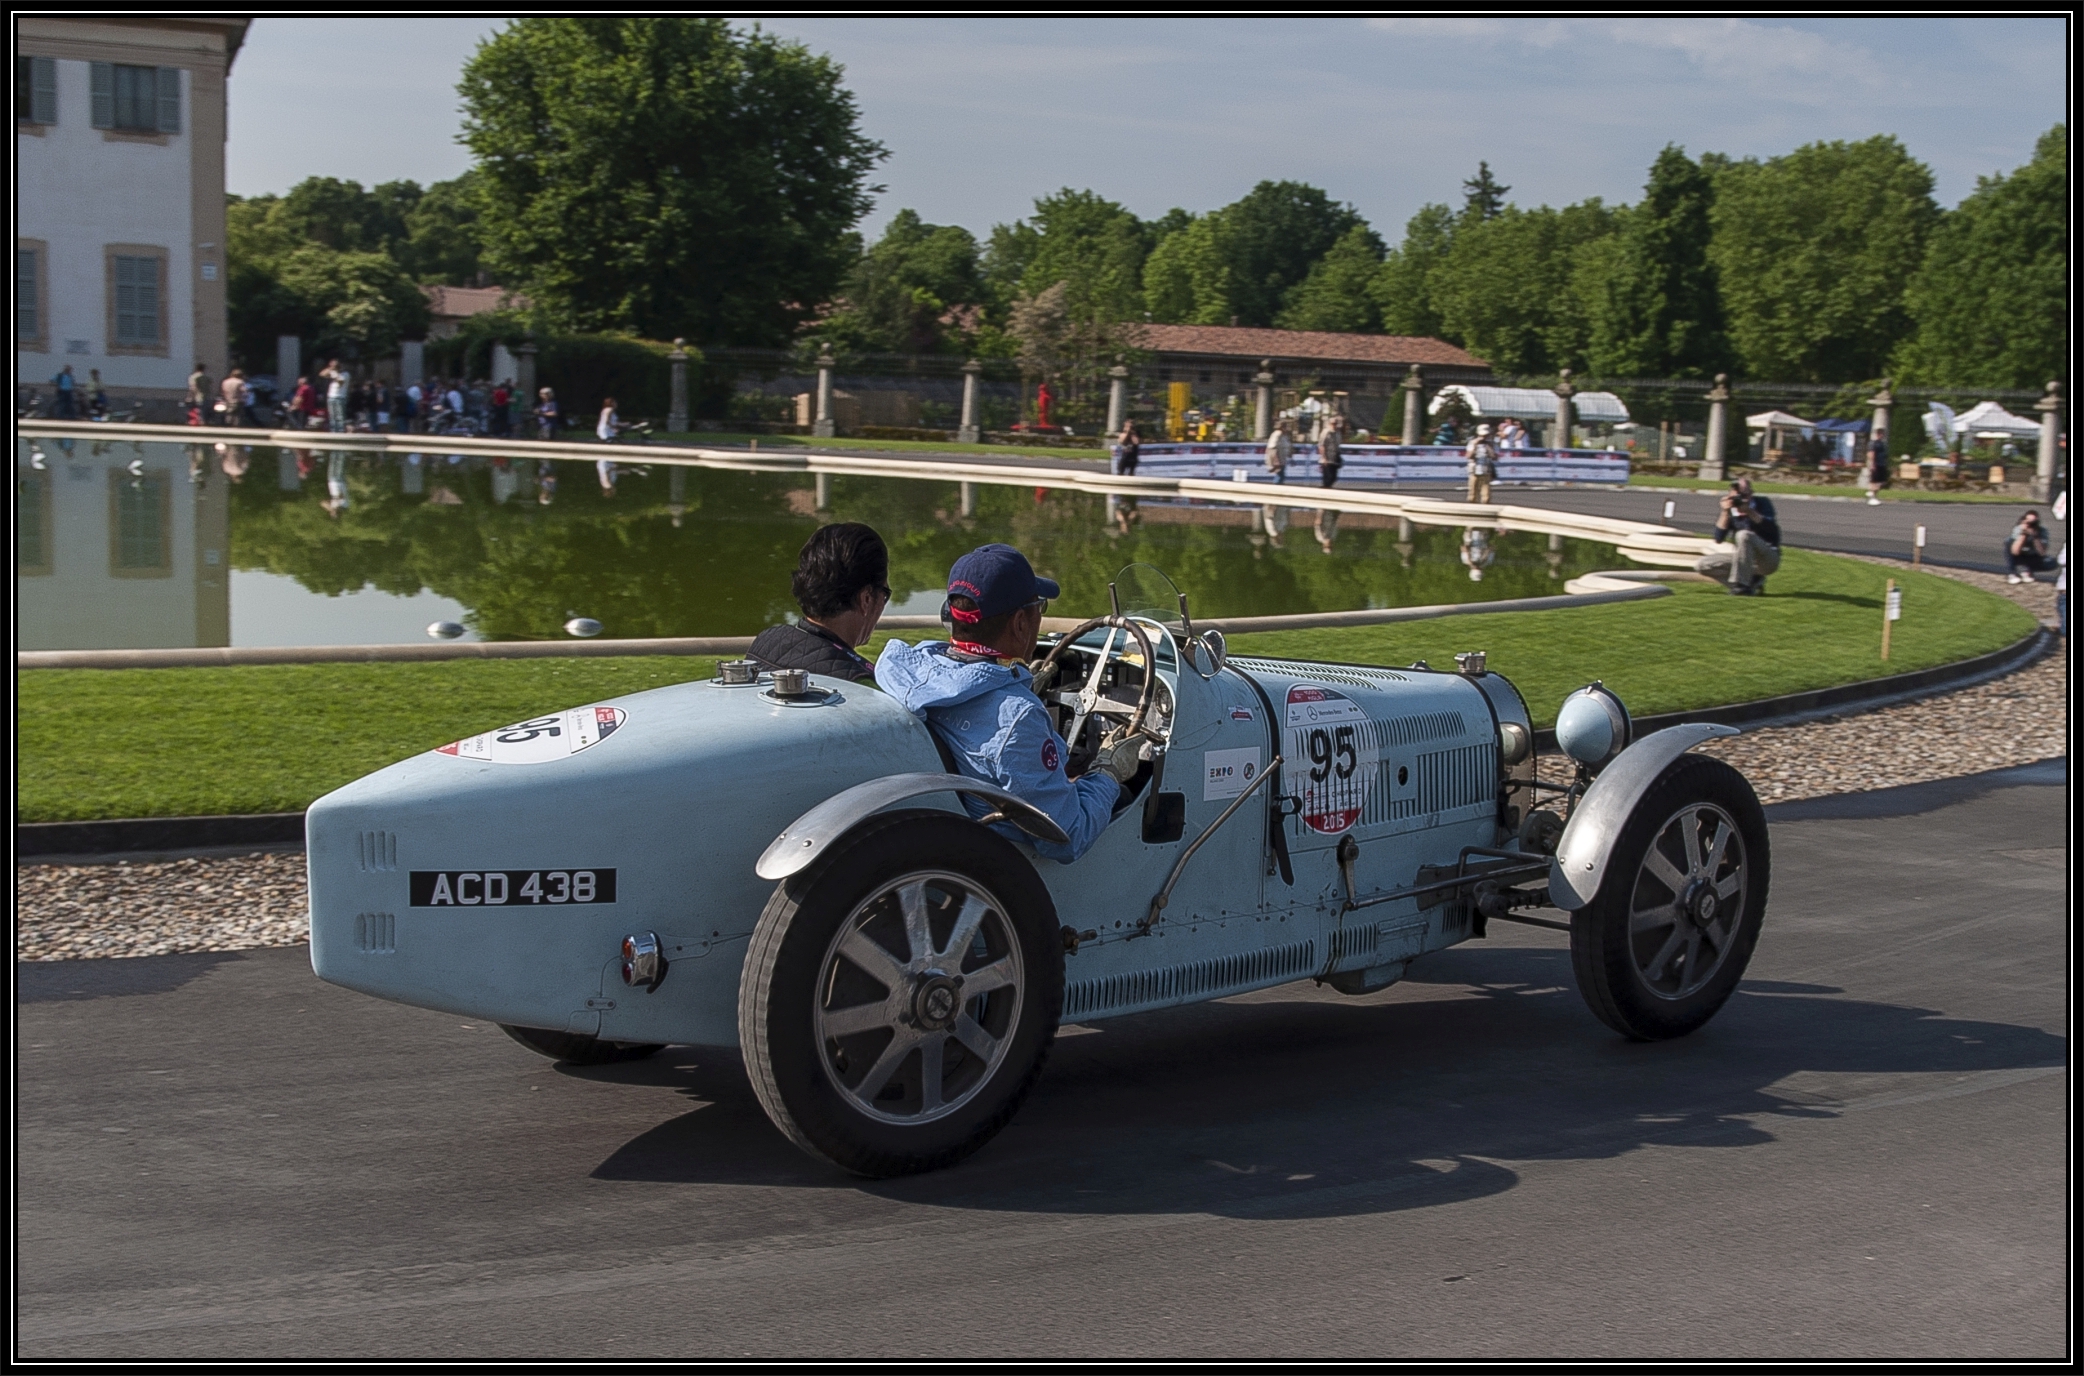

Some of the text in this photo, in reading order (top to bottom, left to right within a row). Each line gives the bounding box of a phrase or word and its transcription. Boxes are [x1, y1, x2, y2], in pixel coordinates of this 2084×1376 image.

[1310, 726, 1357, 783] 95
[1210, 766, 1234, 778] EXPO
[1323, 812, 1346, 830] 2015
[431, 871, 596, 905] ACD 438
